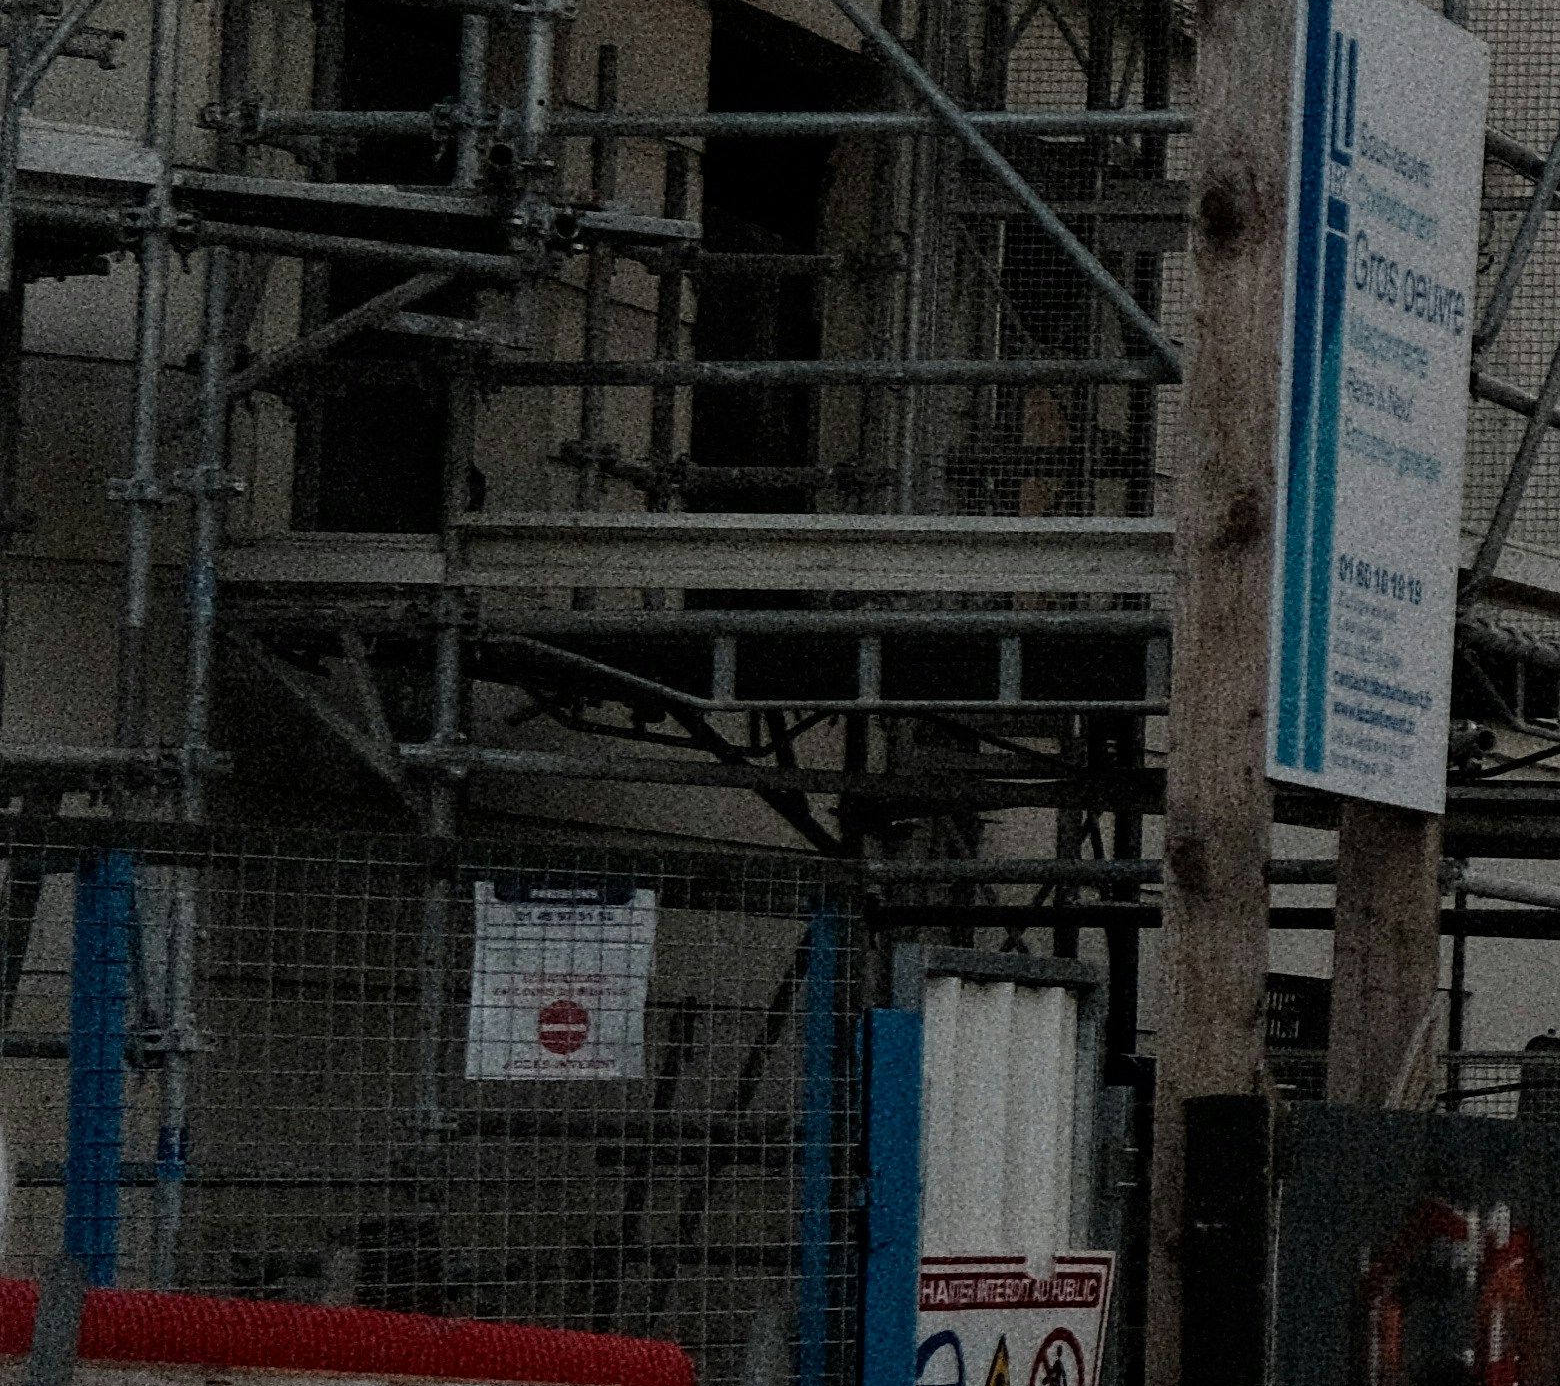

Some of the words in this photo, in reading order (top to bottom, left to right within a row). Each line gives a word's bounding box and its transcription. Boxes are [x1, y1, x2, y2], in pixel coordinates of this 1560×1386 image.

[1355, 229, 1398, 306] Gros
[1404, 269, 1465, 337] oeuvre
[1051, 1277, 1098, 1303] PUBLIC
